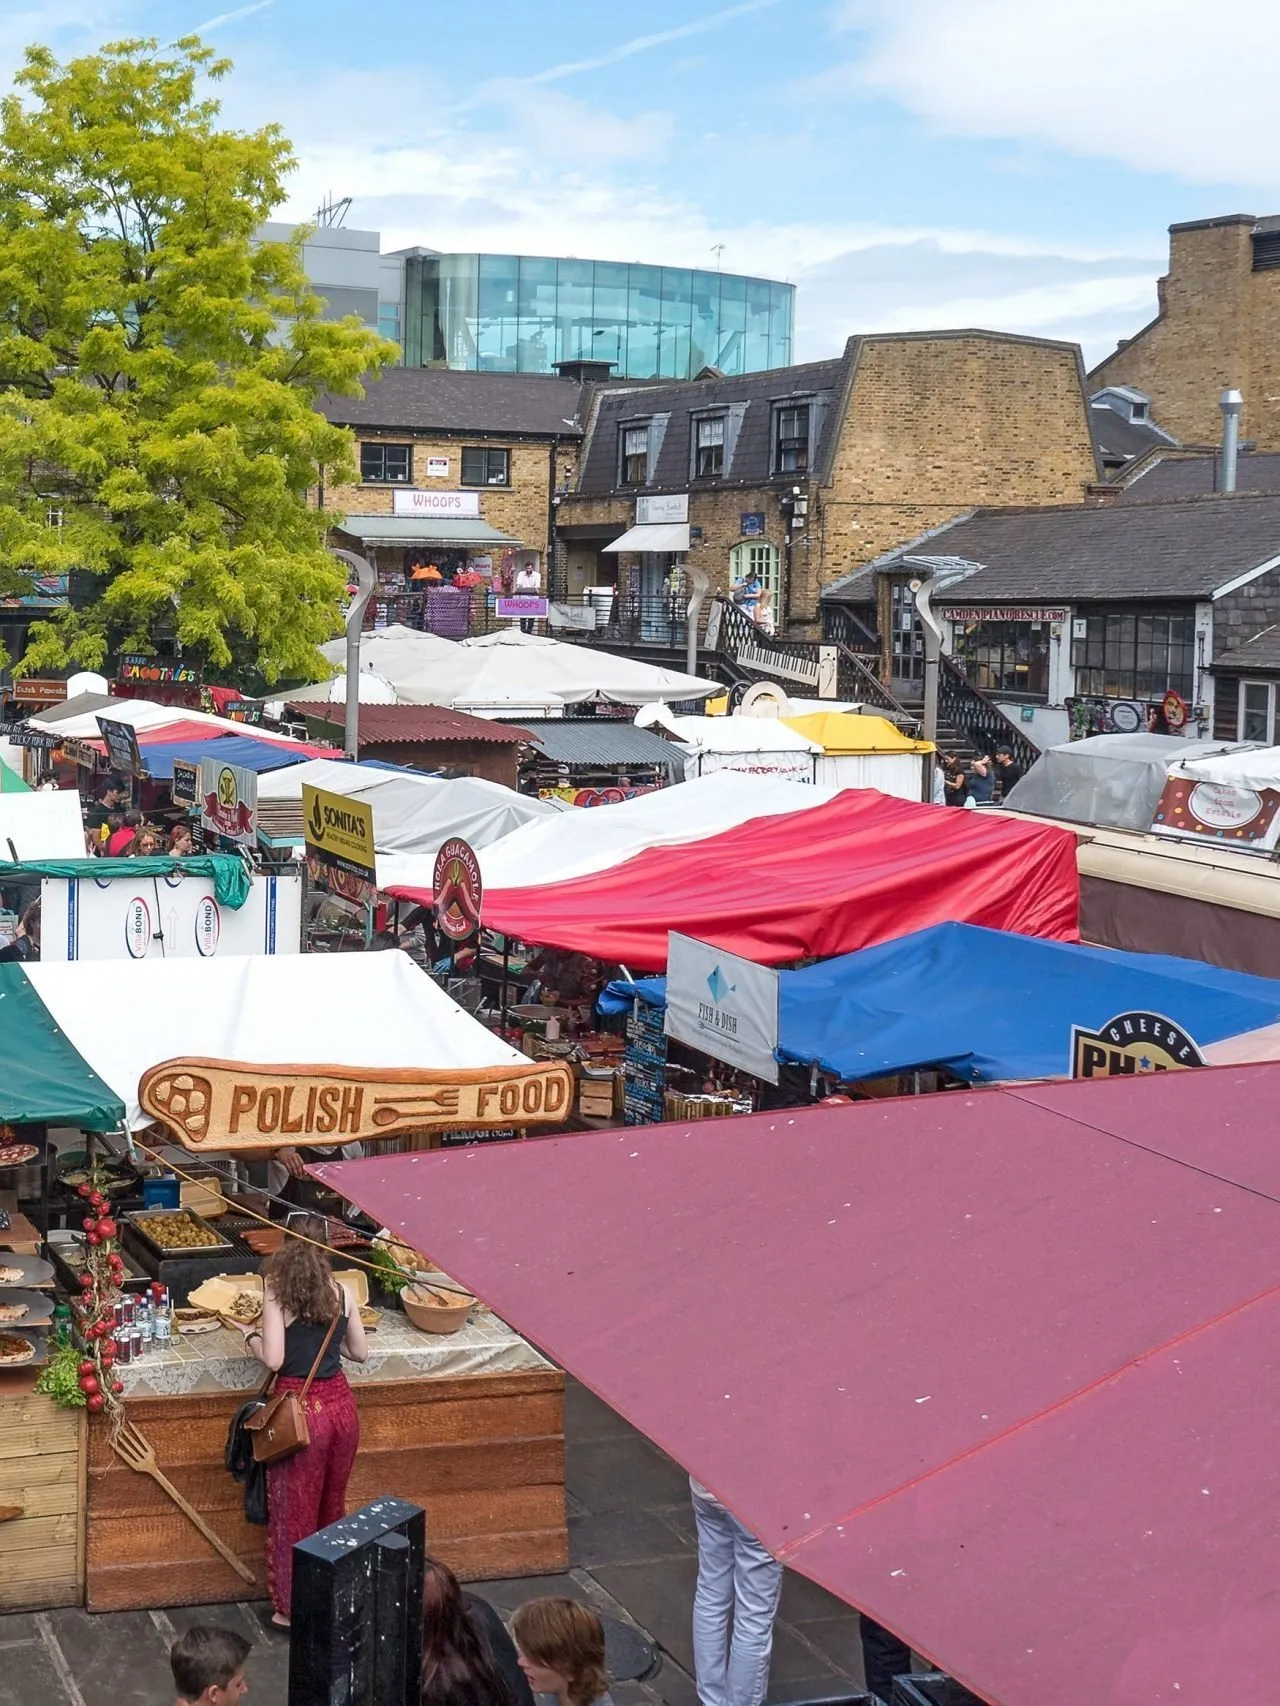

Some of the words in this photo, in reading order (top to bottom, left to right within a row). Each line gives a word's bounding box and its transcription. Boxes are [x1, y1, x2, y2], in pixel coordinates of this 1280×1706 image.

[413, 494, 461, 508] WHOOPS
[504, 600, 540, 608] WHOOPS
[943, 608, 980, 621] CAMDEN
[0, 722, 12, 733] PORK
[10, 735, 31, 745] STICKY
[30, 737, 45, 747] PORK
[324, 806, 366, 838] SONITA'S
[445, 844, 479, 902] GUACAMOLE
[135, 905, 143, 951] VillaBOND
[698, 1002, 715, 1024] FISH
[714, 1010, 720, 1027] &
[721, 1012, 738, 1034] DISH
[1110, 1019, 1190, 1058] CHEESE
[228, 1084, 364, 1133] POLISH
[476, 1076, 567, 1117] FOOD
